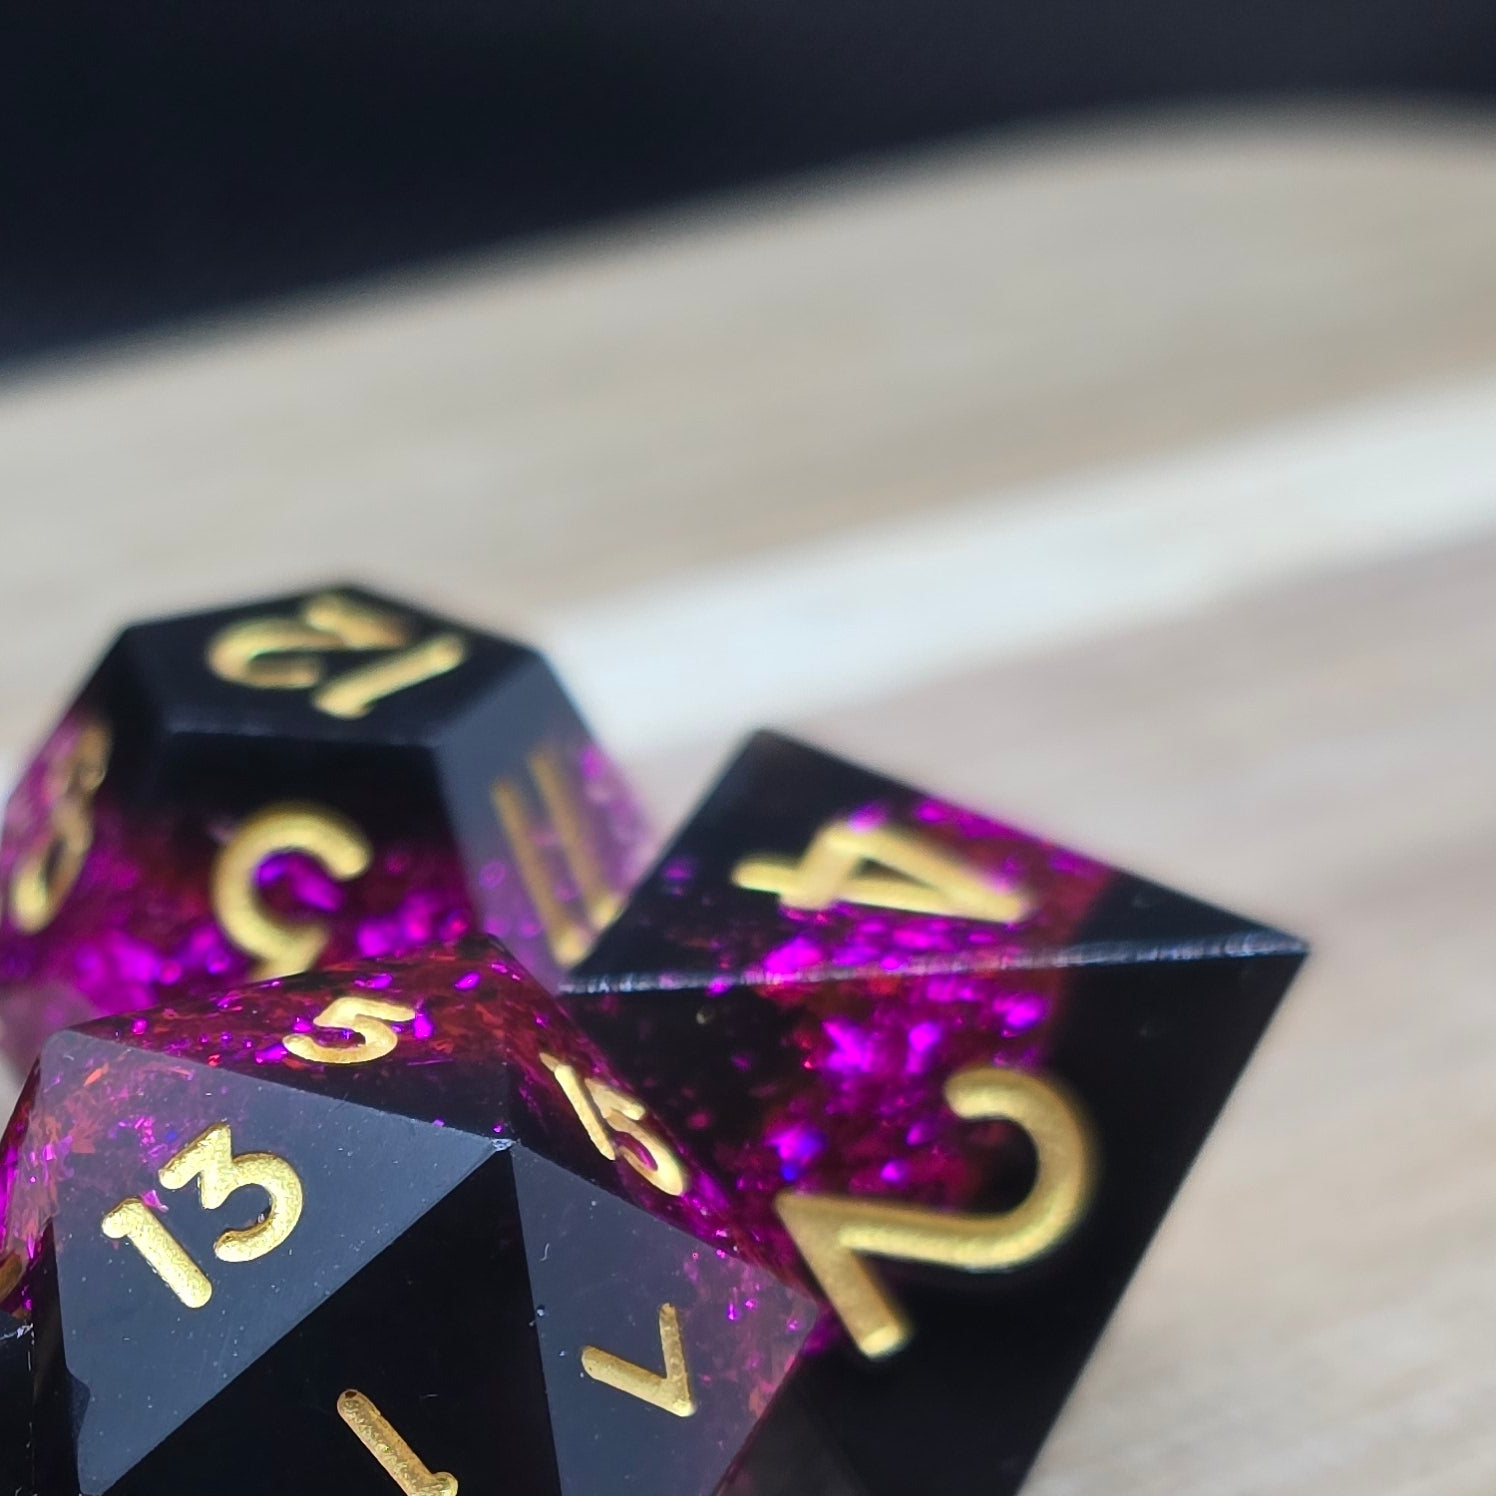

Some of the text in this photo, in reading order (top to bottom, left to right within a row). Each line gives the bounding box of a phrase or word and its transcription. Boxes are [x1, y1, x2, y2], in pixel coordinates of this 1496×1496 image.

[732, 818, 1034, 922] 4
[280, 996, 418, 1066] 5
[100, 1120, 306, 1310] 13
[776, 1066, 1096, 1360] 2
